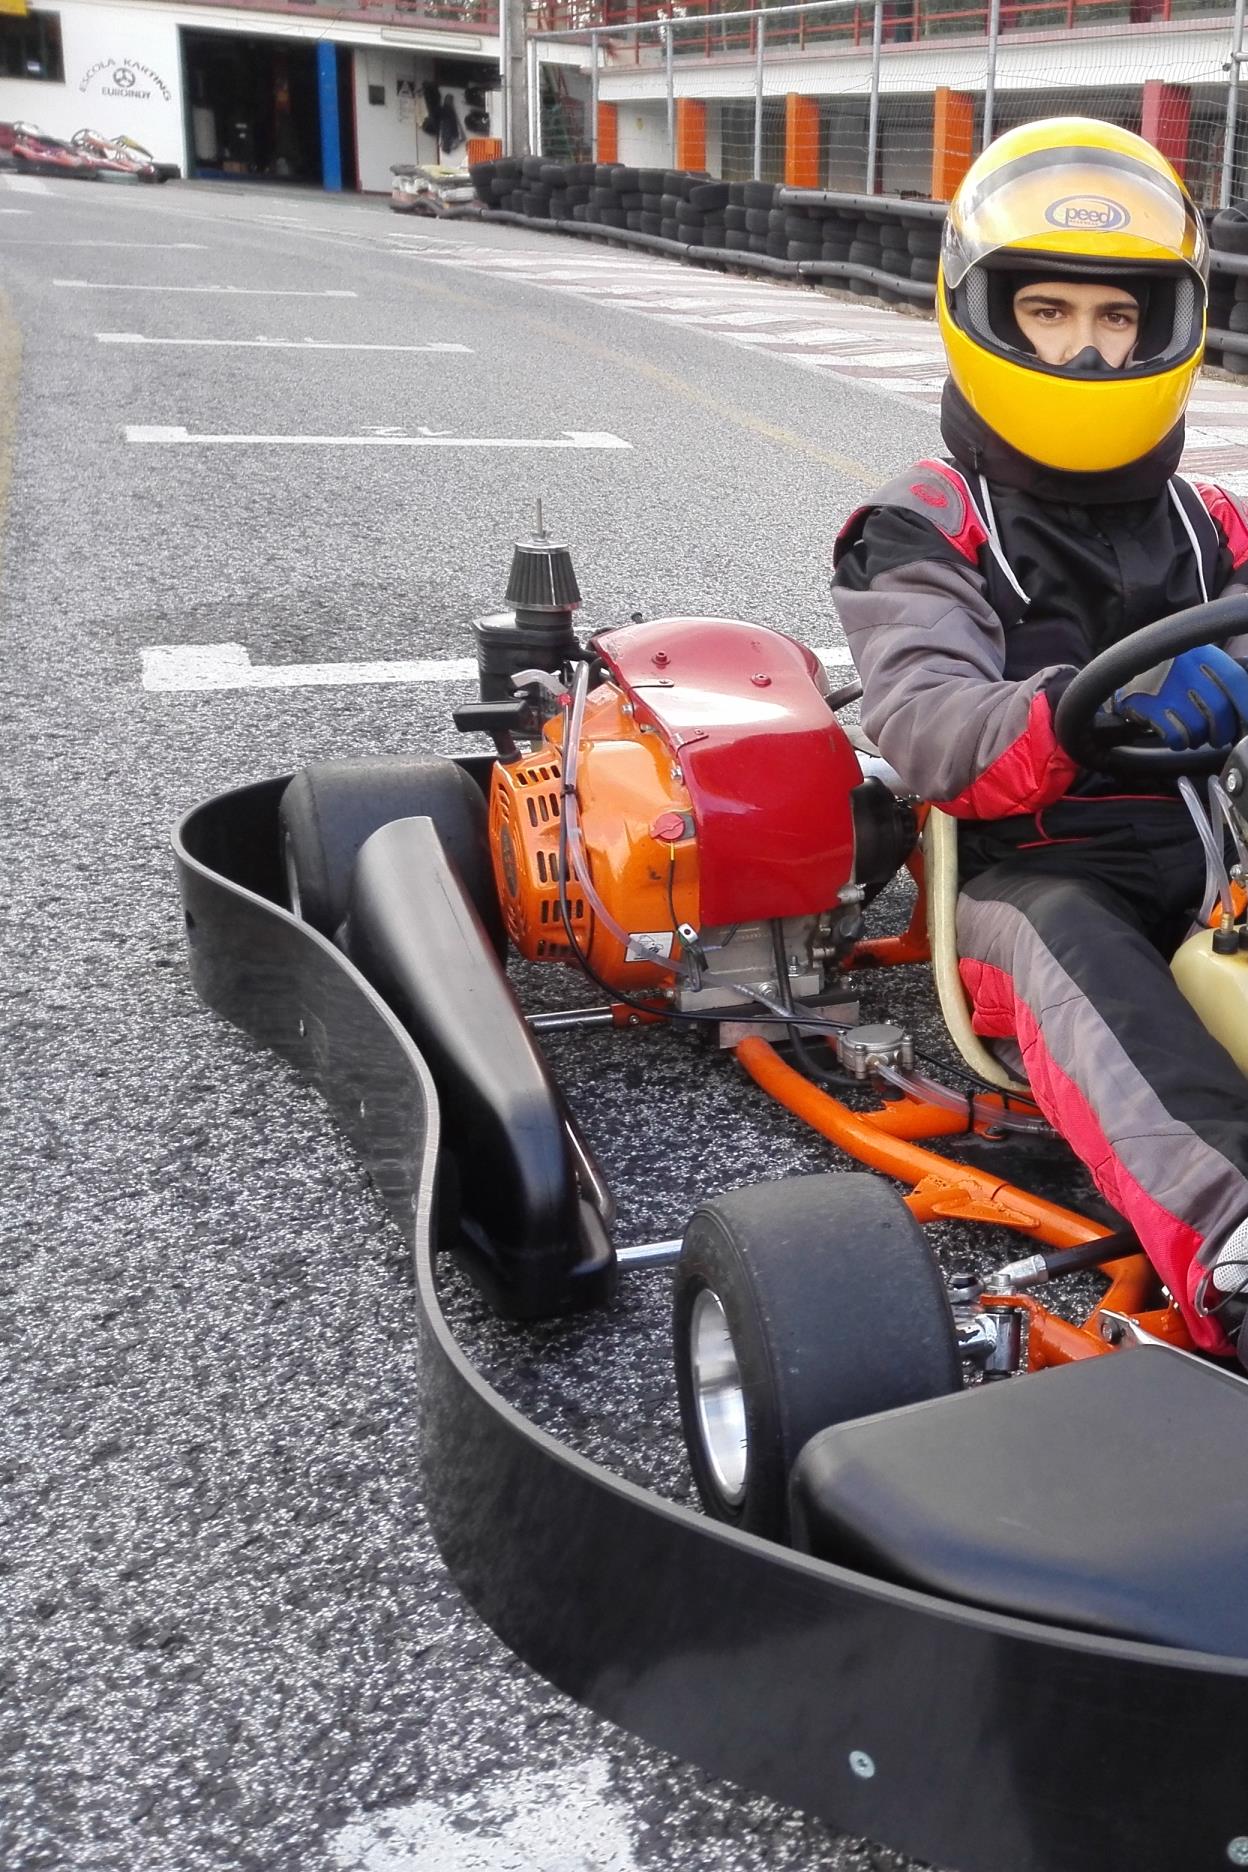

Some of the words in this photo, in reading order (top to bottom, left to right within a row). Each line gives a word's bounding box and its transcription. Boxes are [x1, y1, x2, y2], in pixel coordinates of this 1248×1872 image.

[79, 58, 116, 93] ESCOLA
[123, 58, 171, 101] KARTING
[102, 86, 151, 99] EUROINDY
